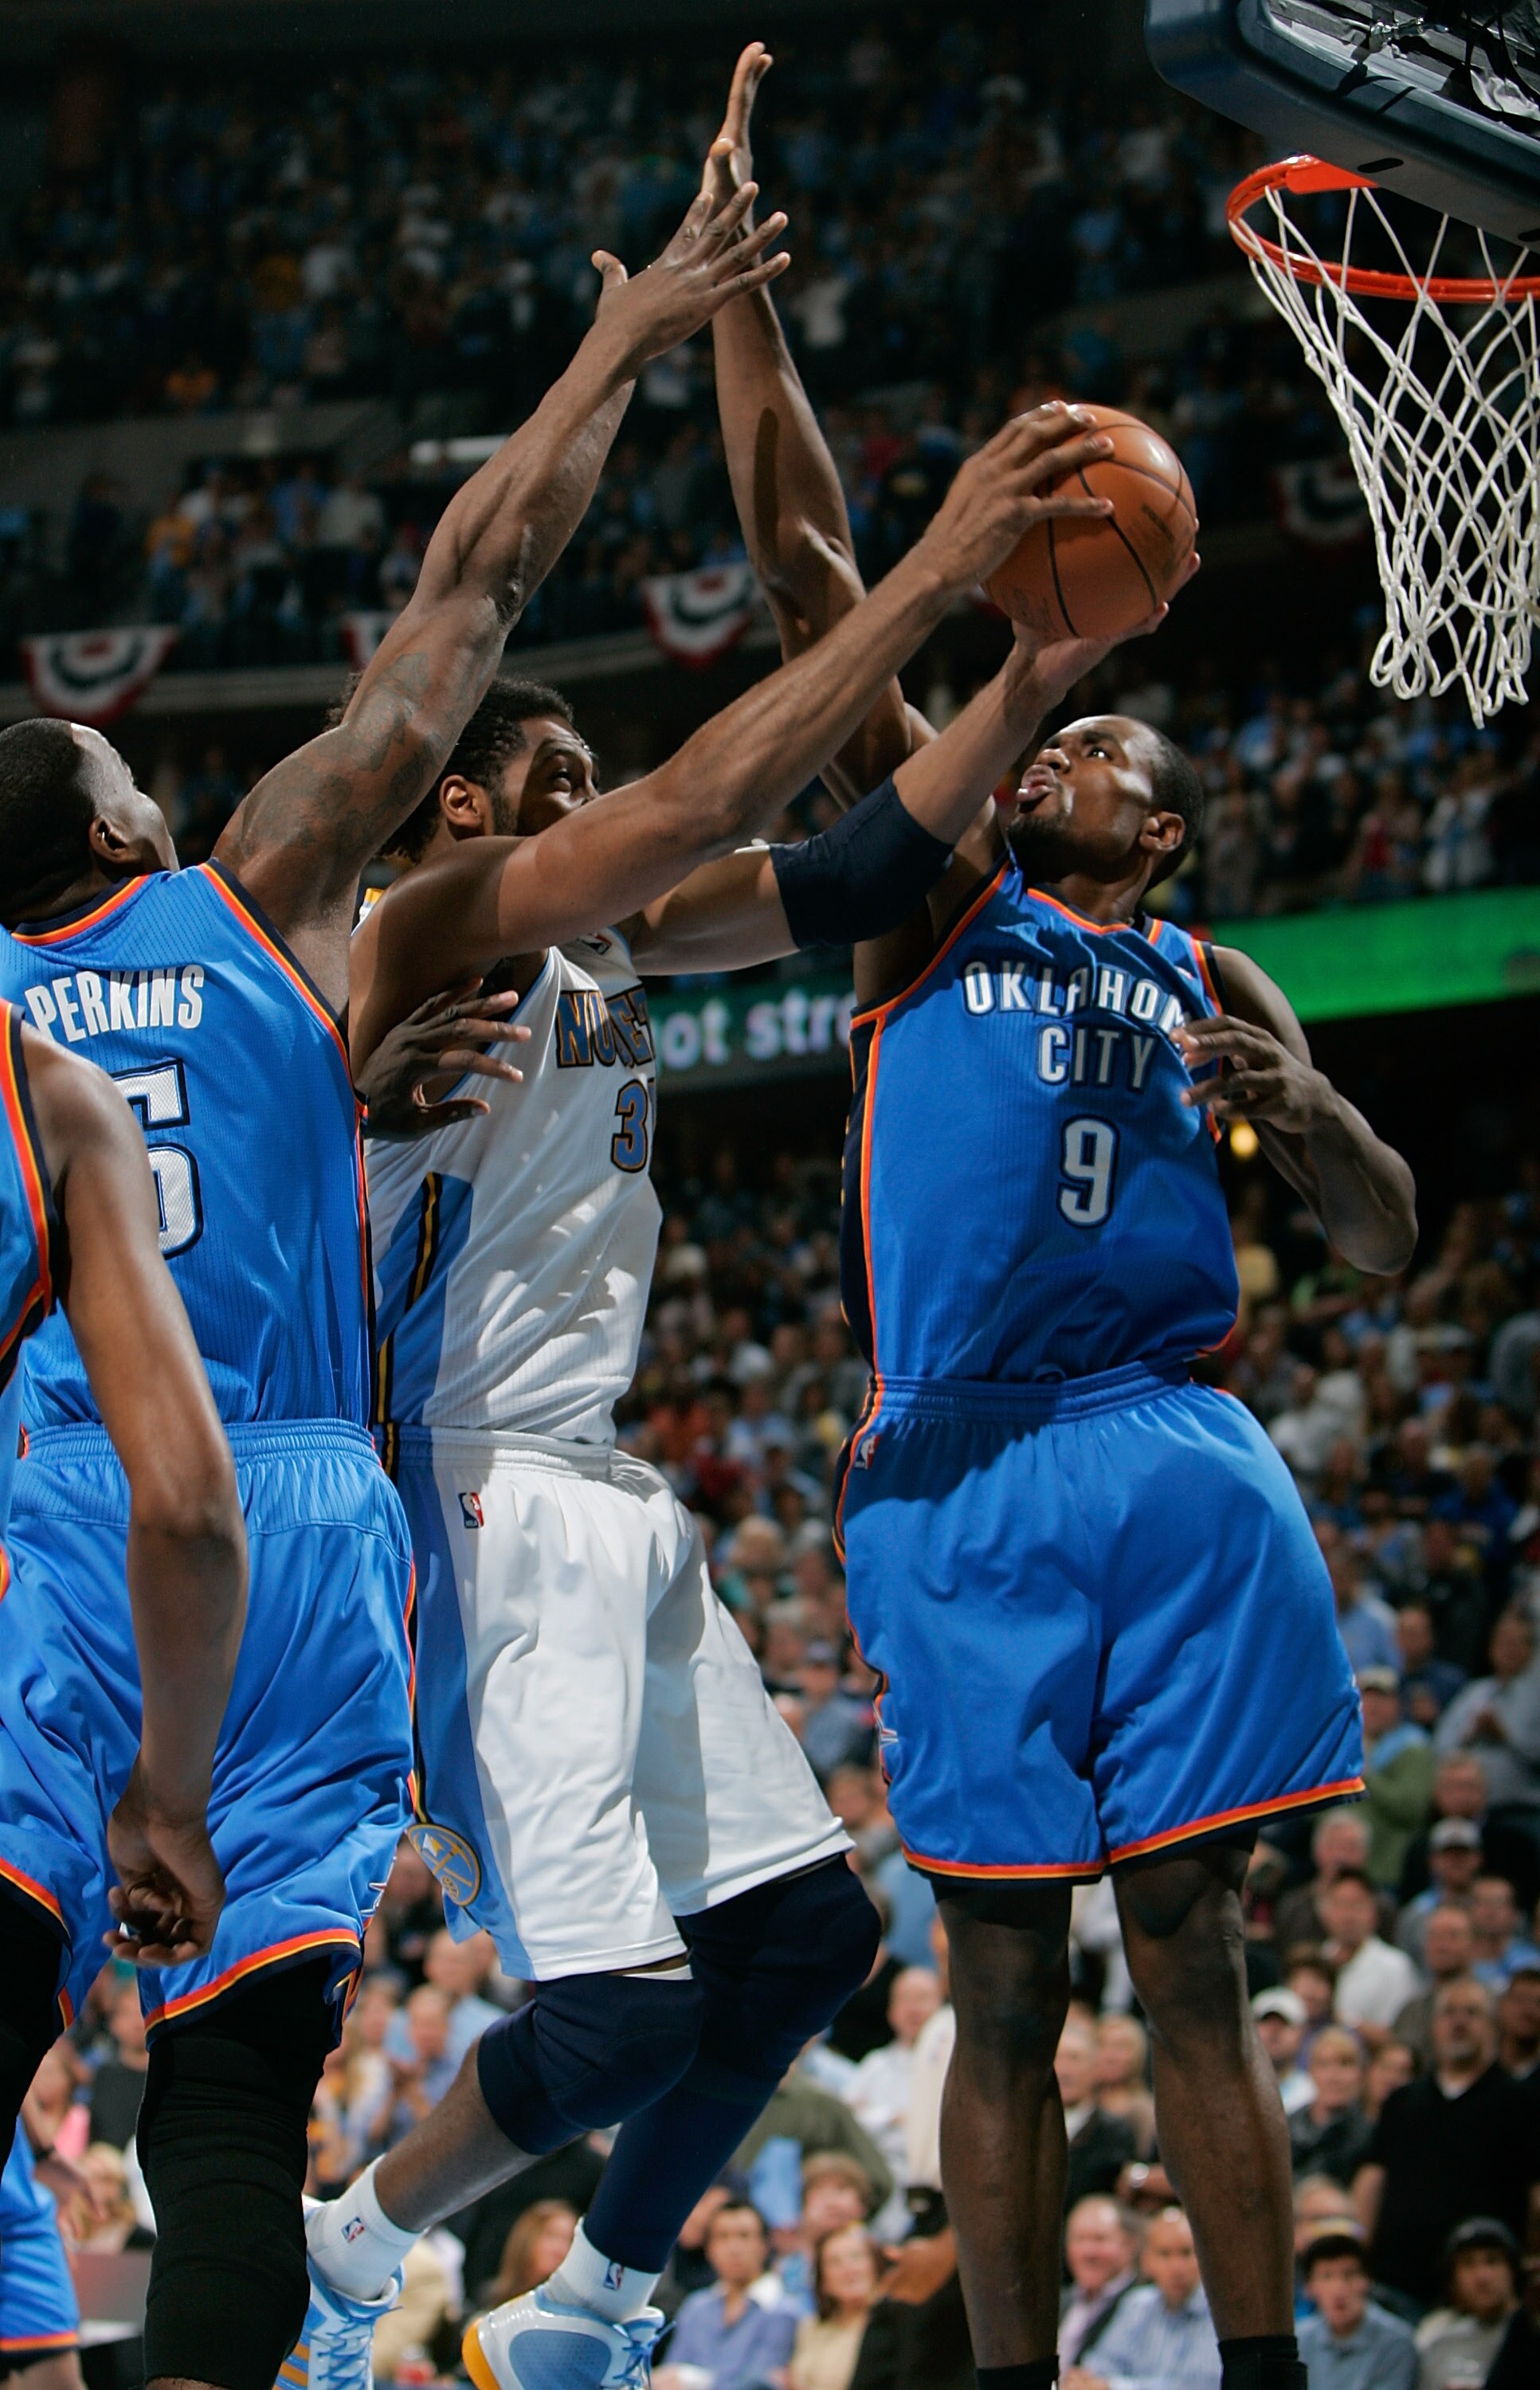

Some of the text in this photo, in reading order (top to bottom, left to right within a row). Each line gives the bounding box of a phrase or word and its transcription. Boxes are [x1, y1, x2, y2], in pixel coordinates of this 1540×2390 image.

[25, 964, 205, 1043] PERKINS
[655, 998, 729, 1071] ot
[1038, 1023, 1156, 1093] CITY
[1057, 1114, 1119, 1228] 9
